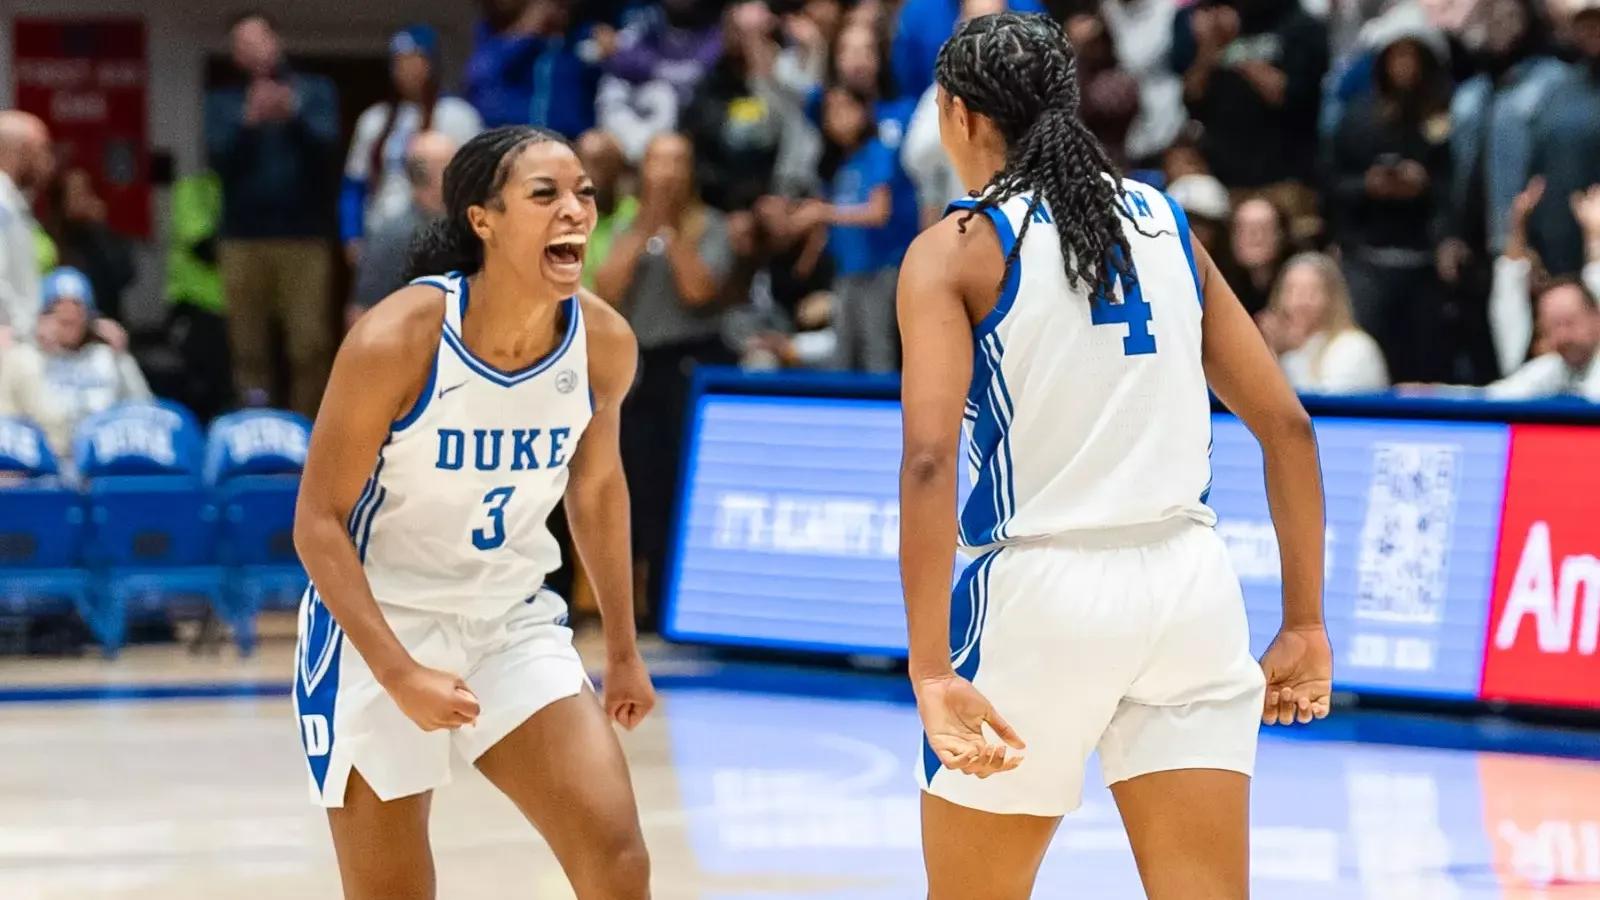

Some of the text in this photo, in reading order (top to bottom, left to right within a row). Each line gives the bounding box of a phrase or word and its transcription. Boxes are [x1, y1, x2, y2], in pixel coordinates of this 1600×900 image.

[1090, 241, 1157, 356] 4
[435, 427, 571, 471] DUKE
[472, 486, 516, 551] 3
[301, 714, 330, 757] D
